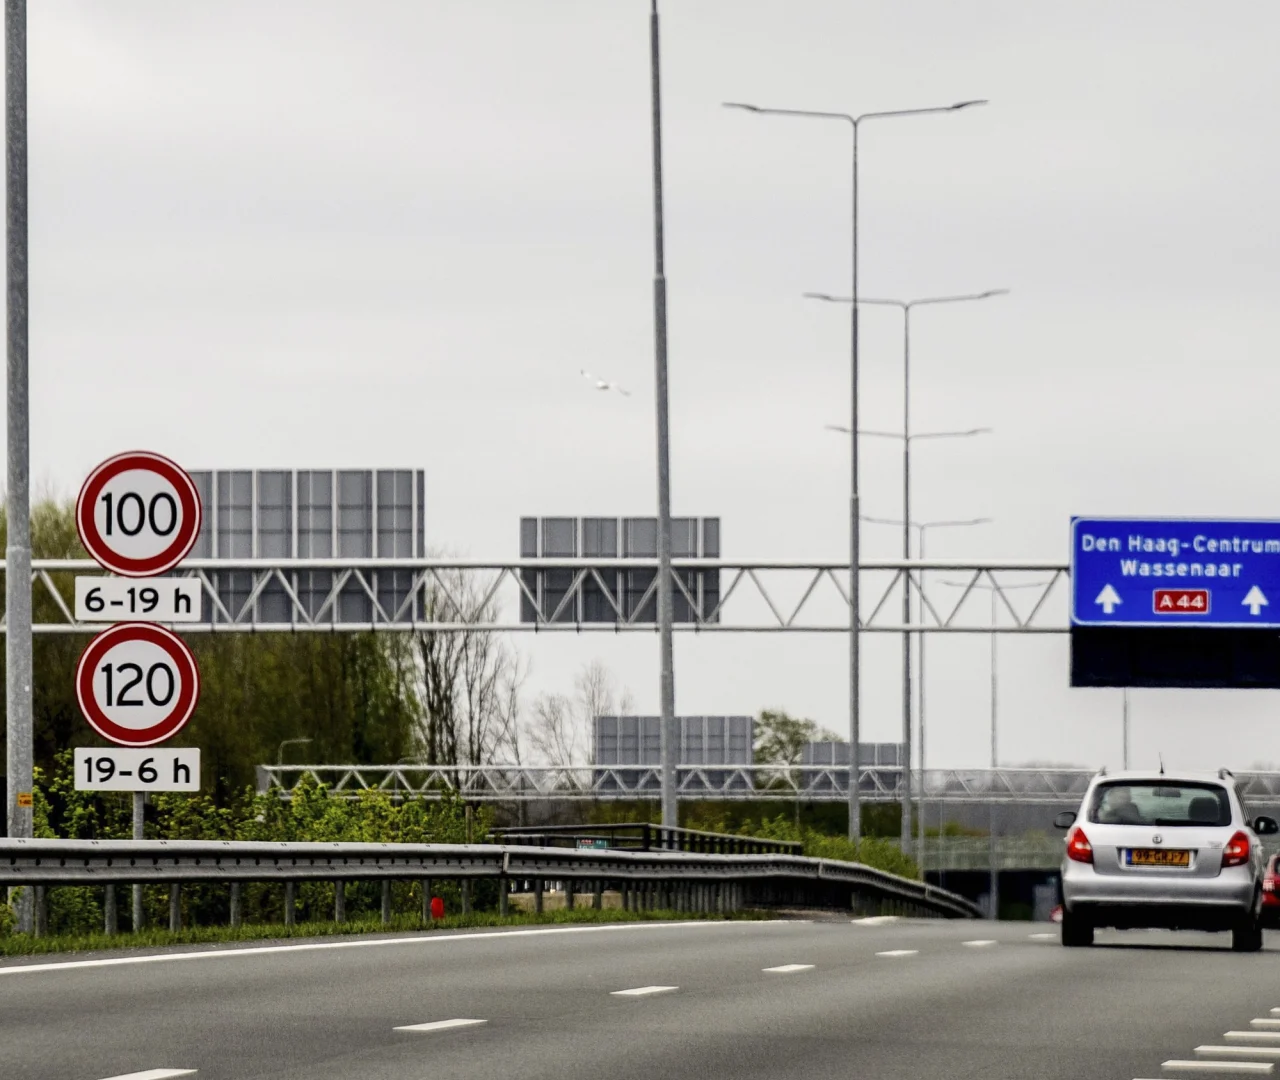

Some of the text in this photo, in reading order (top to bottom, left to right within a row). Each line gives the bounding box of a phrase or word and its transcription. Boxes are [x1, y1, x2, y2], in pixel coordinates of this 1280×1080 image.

[101, 492, 177, 536] 100
[1082, 534, 1121, 552] Den
[1120, 559, 1243, 577] Wassenaar
[84, 587, 191, 614] 6-19 h
[101, 662, 175, 706] 120
[84, 756, 191, 784] 19-6 h
